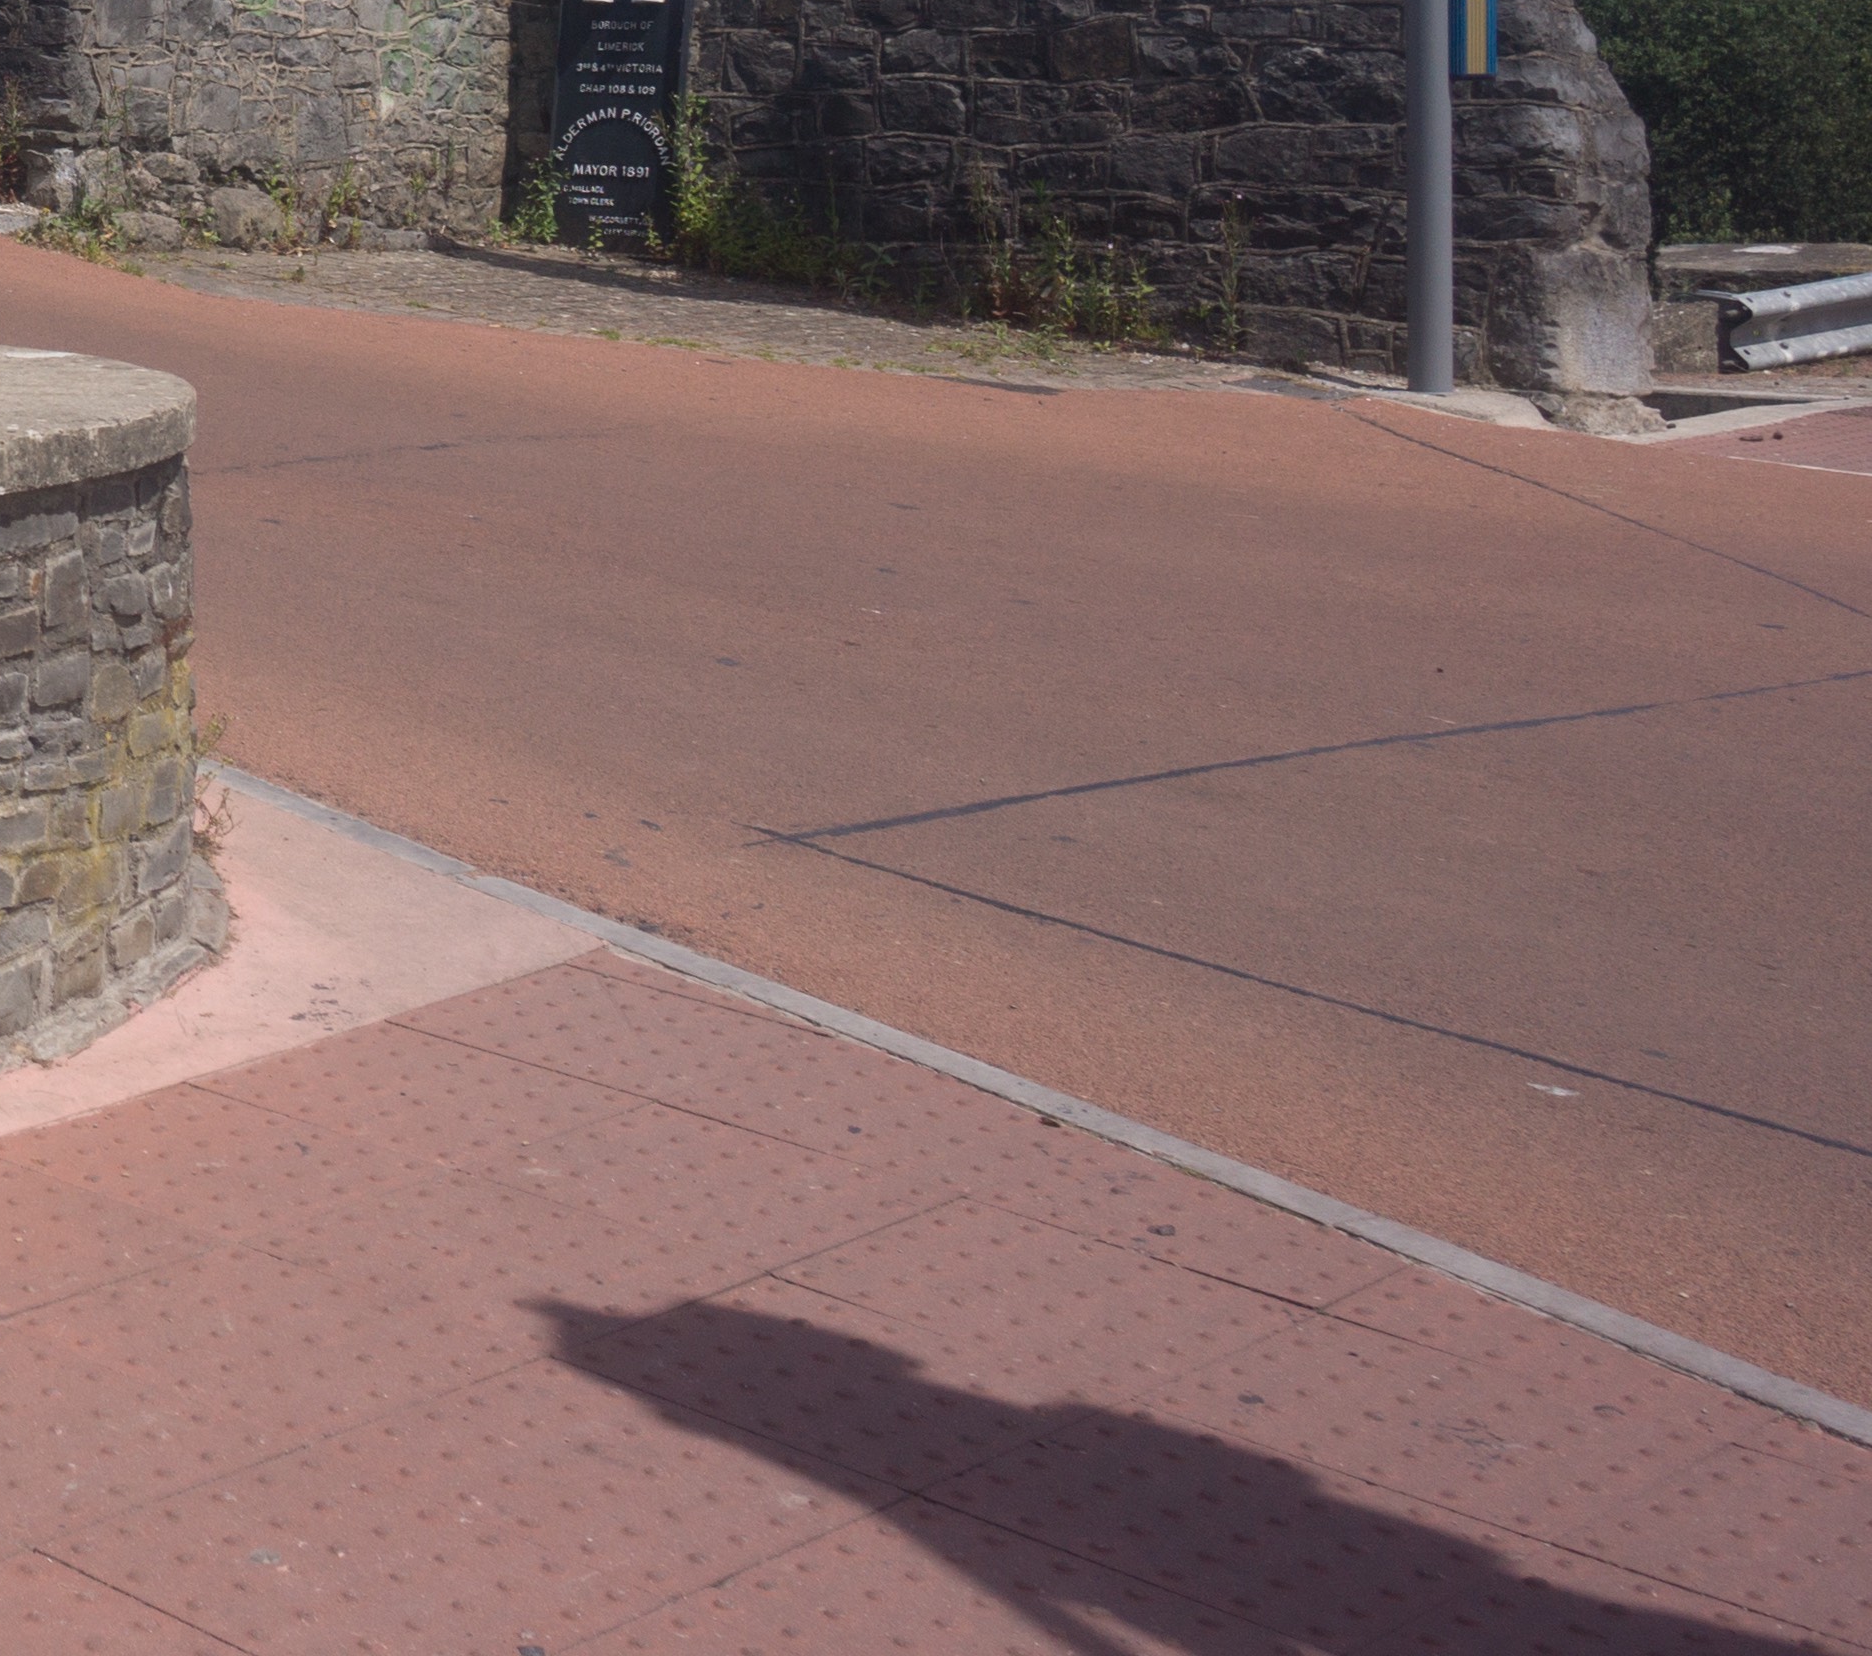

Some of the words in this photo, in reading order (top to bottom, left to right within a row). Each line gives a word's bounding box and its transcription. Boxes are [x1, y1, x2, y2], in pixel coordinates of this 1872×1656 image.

[591, 20, 637, 30] BOROUGH
[640, 20, 654, 30] OF
[597, 41, 645, 52] LIMERICK
[617, 63, 663, 73] VICTORIA
[579, 84, 605, 93] CHAP
[638, 85, 656, 95] 109
[555, 107, 617, 161] ALDERMAN
[572, 163, 617, 177] MAYOR
[622, 165, 650, 178] 1891
